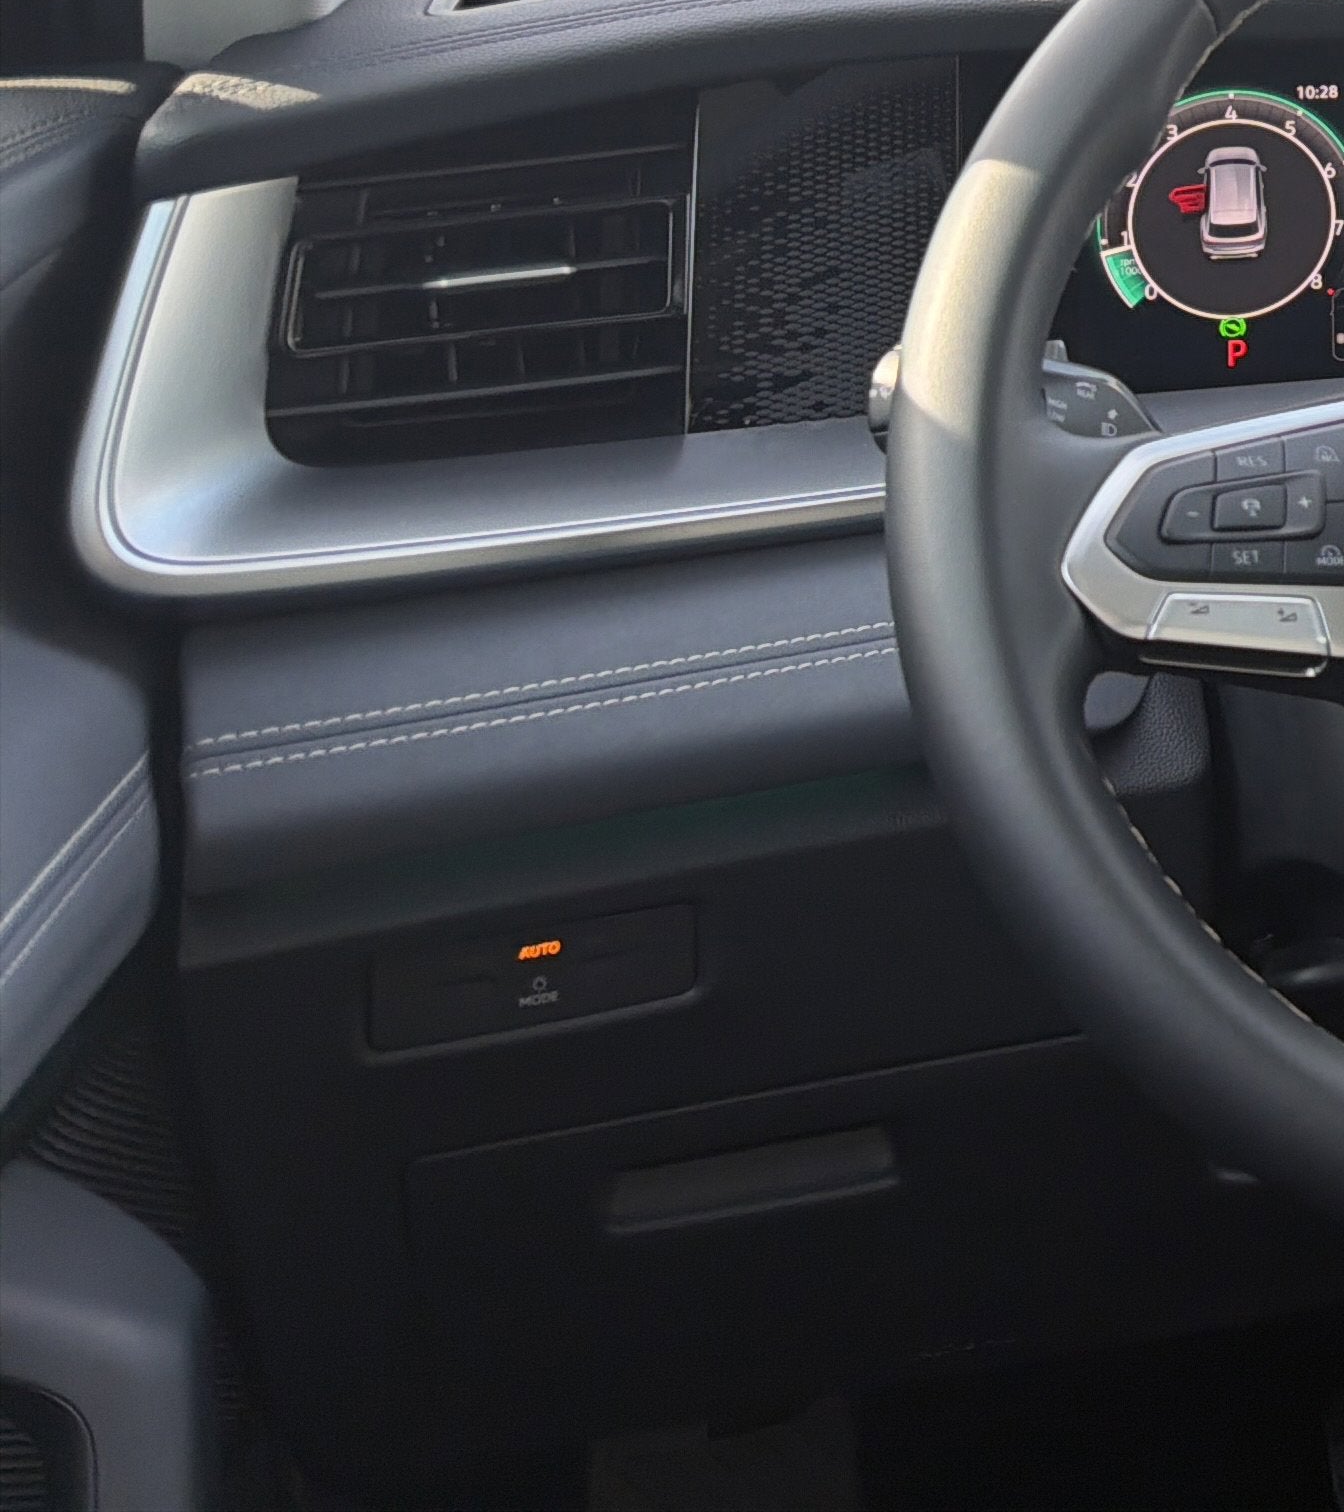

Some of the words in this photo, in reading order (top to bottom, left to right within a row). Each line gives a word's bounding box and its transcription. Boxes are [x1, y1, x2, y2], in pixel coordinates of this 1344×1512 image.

[1296, 84, 1339, 100] 10:28
[1224, 105, 1238, 120] 4
[1165, 124, 1179, 142] 3
[1284, 120, 1297, 137] 5
[1324, 162, 1337, 180] 6
[1120, 230, 1129, 246] 1
[1310, 272, 1323, 289] 8
[1144, 283, 1158, 301] 0
[1227, 339, 1249, 367] P
[1235, 455, 1268, 468] RES
[1232, 550, 1260, 565] SET
[518, 941, 561, 960] AUTO
[519, 991, 559, 1007] MODE
